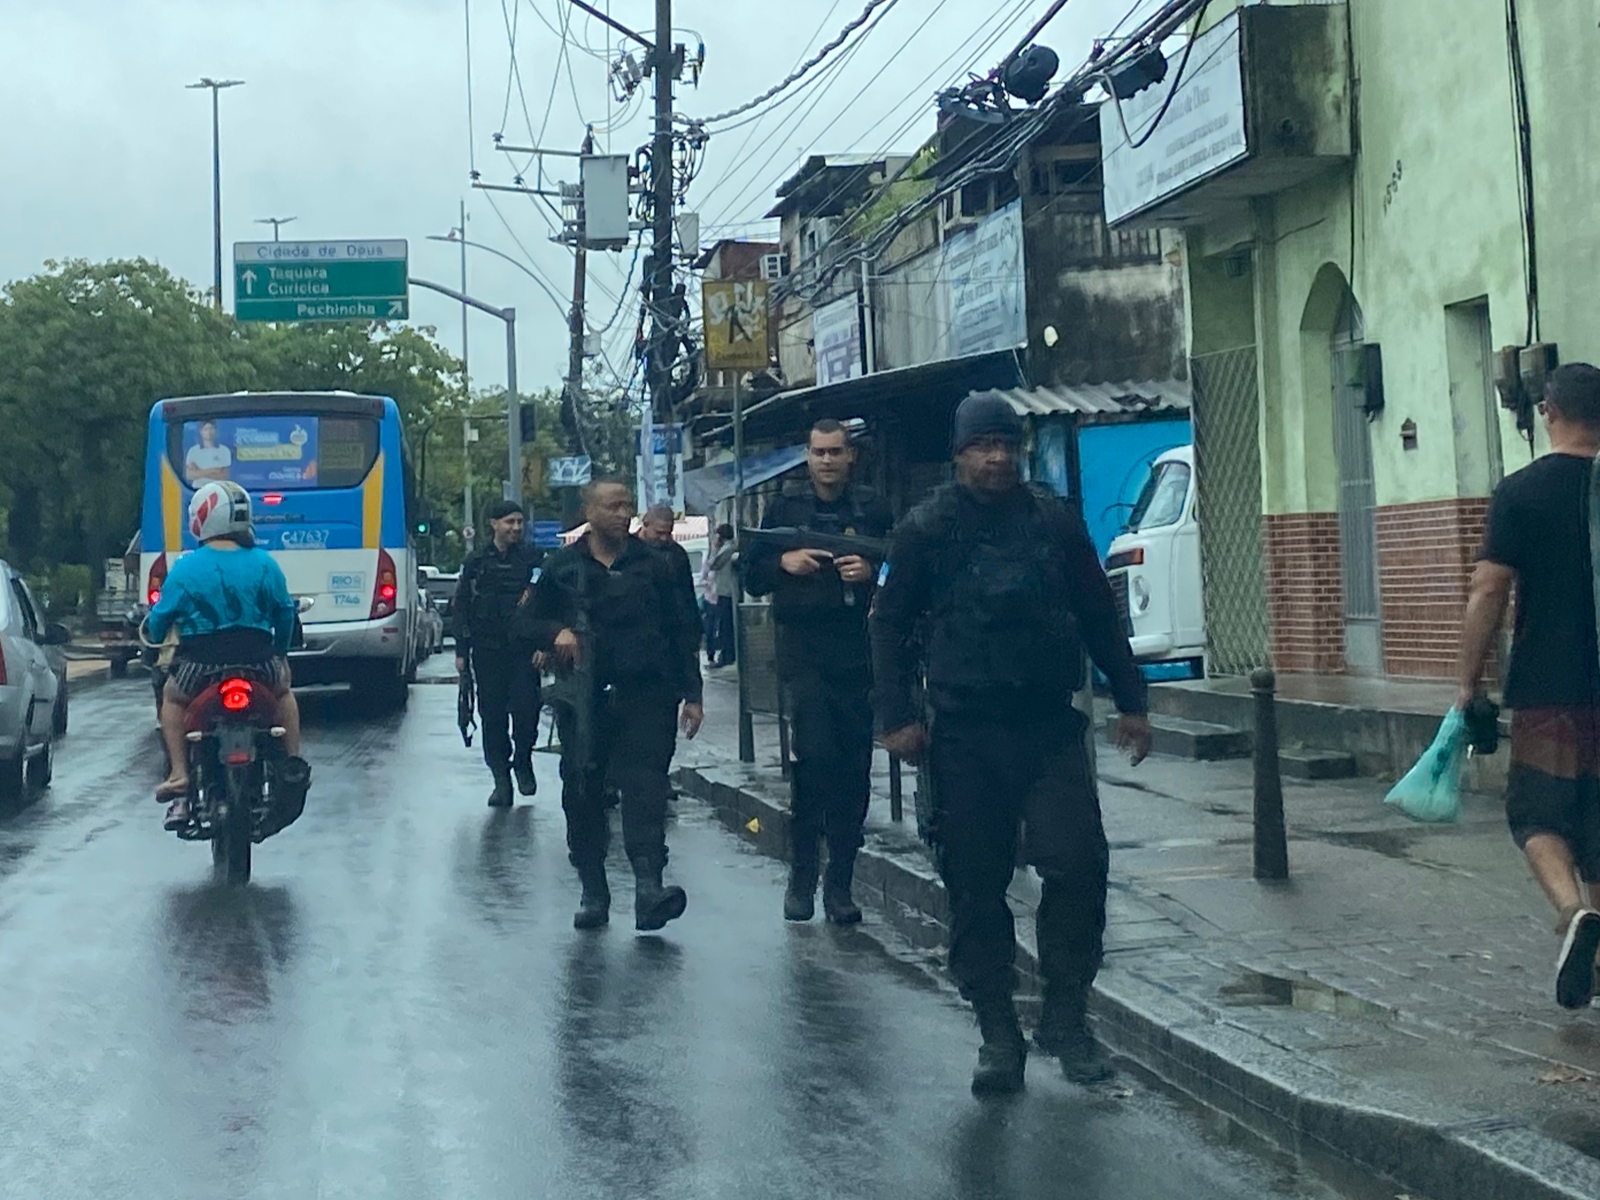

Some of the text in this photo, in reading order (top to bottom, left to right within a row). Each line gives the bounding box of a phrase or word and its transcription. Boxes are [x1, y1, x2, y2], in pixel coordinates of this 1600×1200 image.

[257, 244, 384, 259] Cidade de Deus
[268, 267, 328, 281] Taquara
[268, 282, 330, 296] Curicica
[297, 303, 376, 316] Pechincha
[281, 529, 329, 543] C47637
[332, 575, 353, 585] RIO
